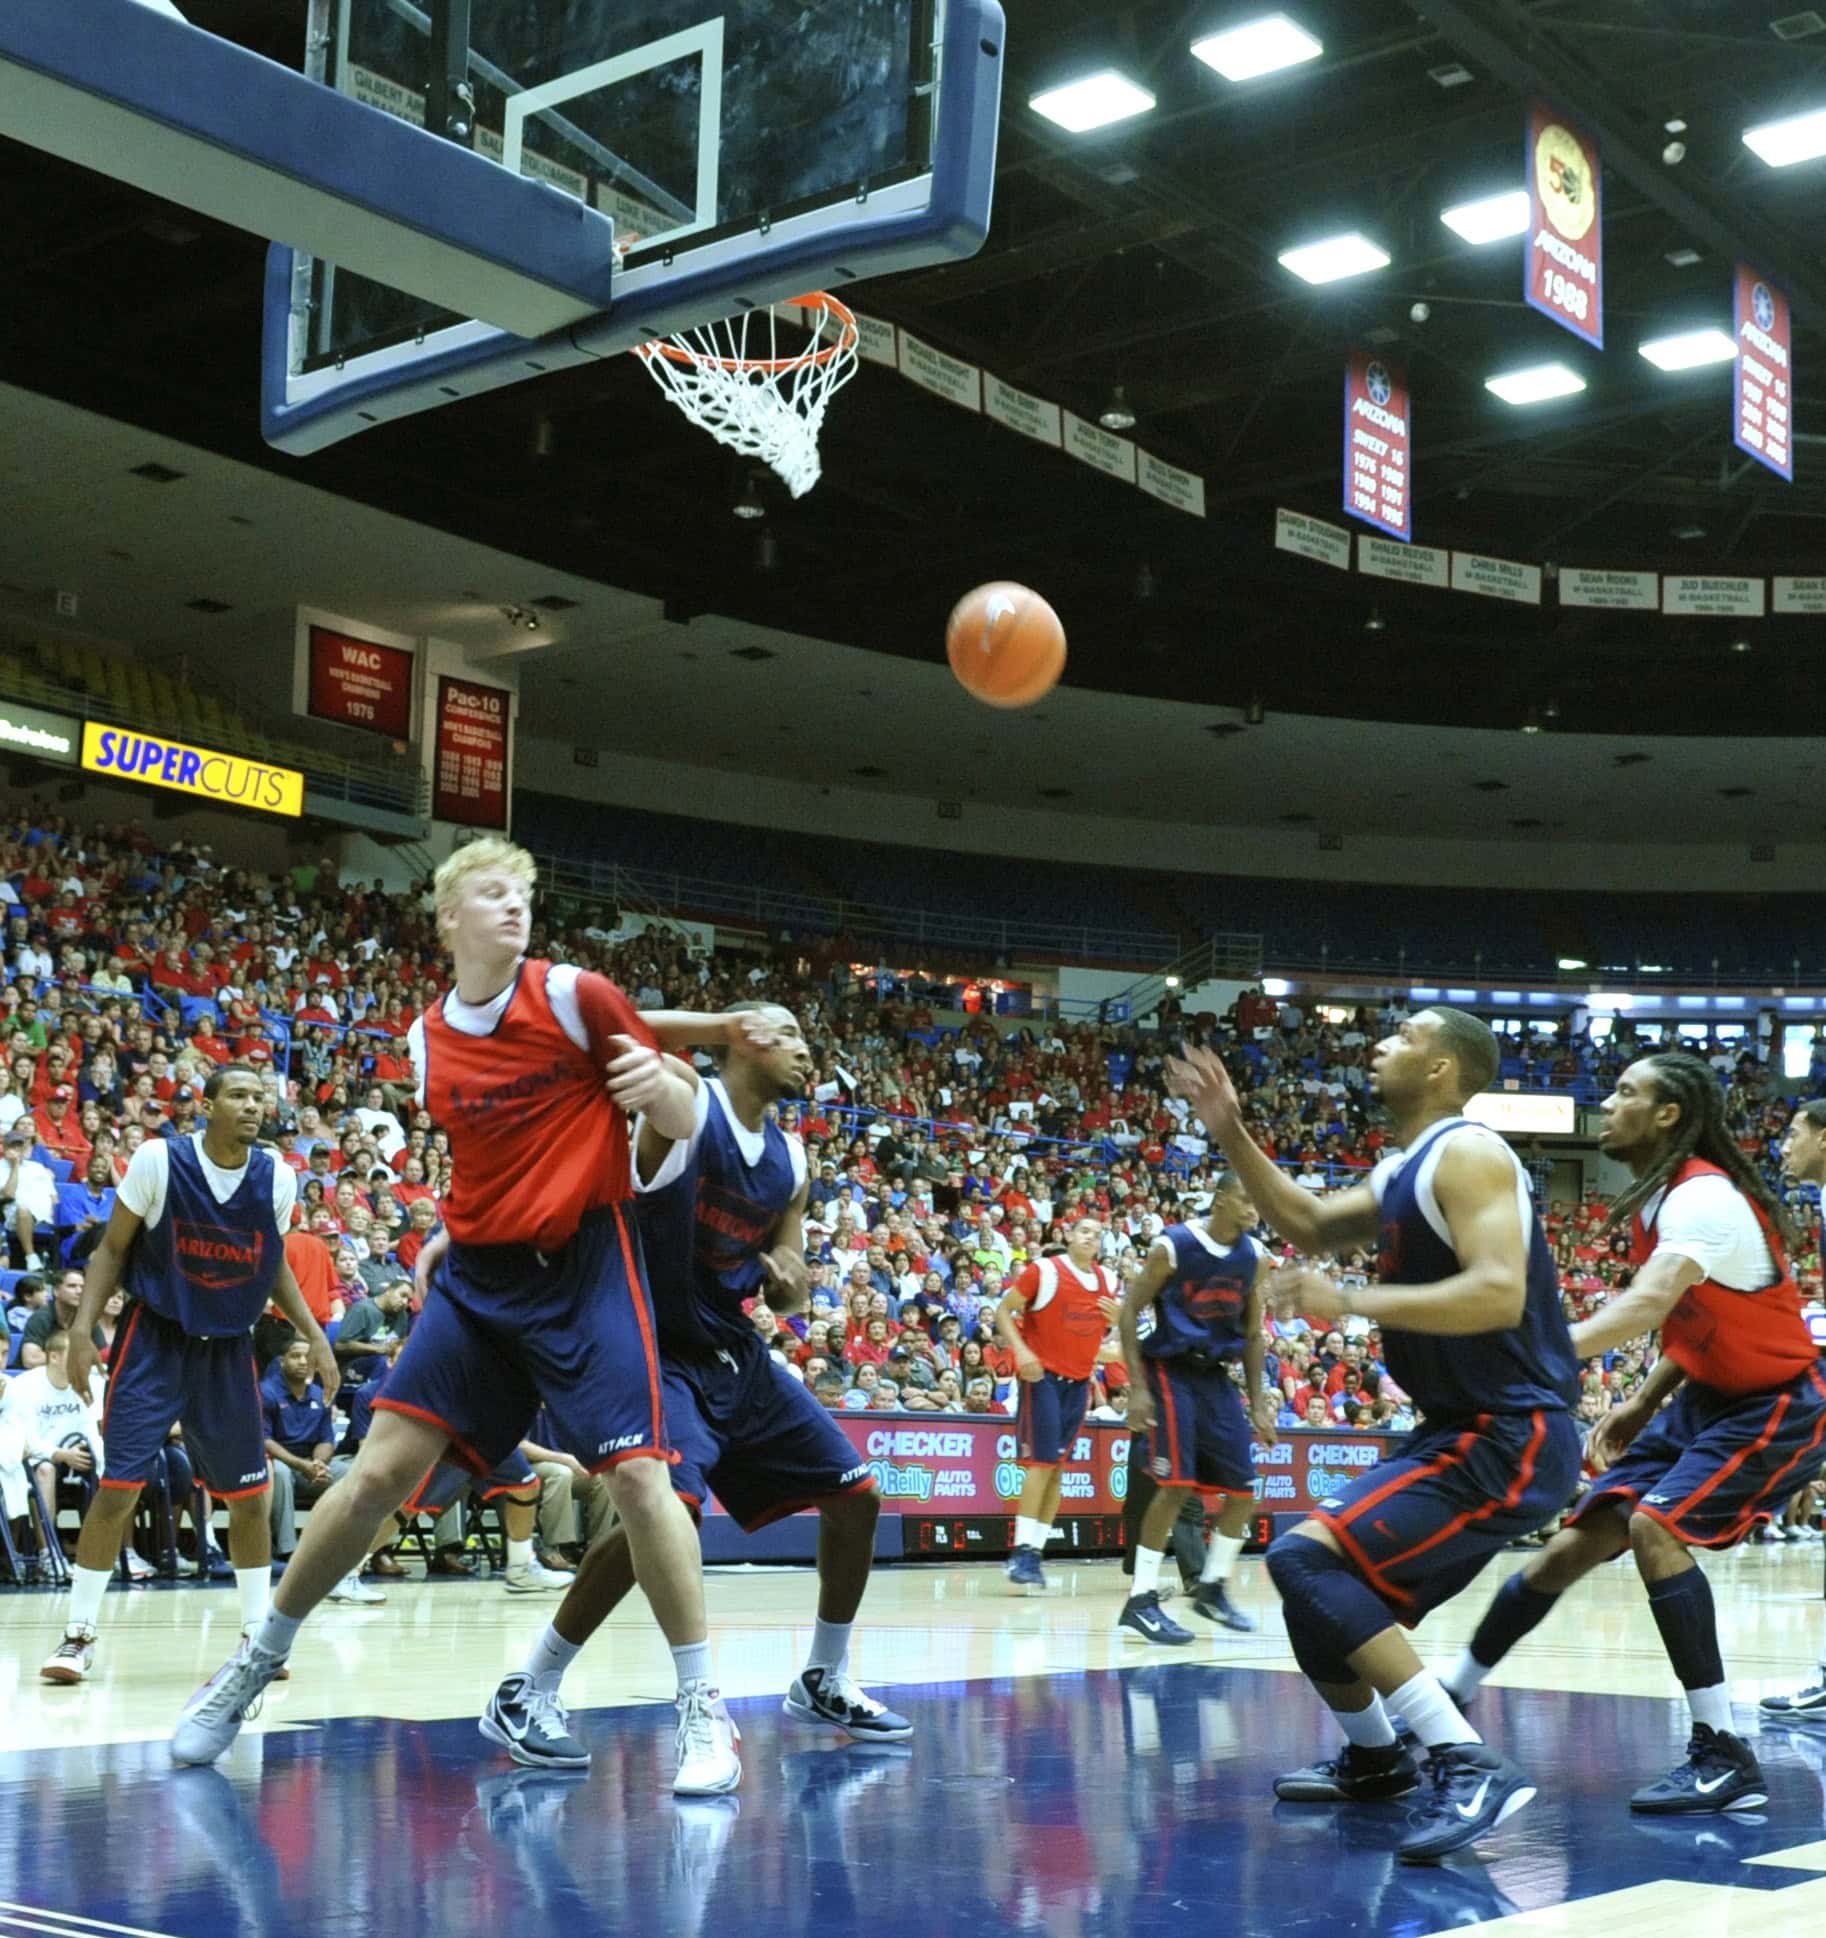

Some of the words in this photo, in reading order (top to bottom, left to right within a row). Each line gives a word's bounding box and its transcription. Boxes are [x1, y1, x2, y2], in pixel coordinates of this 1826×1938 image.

[1534, 229, 1596, 285] ARIZONA
[1544, 268, 1588, 320] 1988
[1353, 397, 1406, 437] ARIZONA
[1402, 546, 1435, 562] REEVES
[1471, 557, 1498, 572] CHRIS
[1498, 563, 1523, 579] MILLS
[1578, 572, 1604, 584] SEAN
[1606, 572, 1638, 586] ROOKS
[1464, 570, 1529, 590] M-BASKETBALL
[1680, 579, 1699, 591] JUD
[1701, 580, 1750, 592] BUECHLER
[1678, 593, 1751, 603] M-BASKETBALL
[341, 644, 382, 671] WAC
[346, 700, 375, 721] 1976
[447, 685, 501, 714] Pac-10
[445, 702, 502, 724] CONFERENCE
[95, 731, 286, 807] SUPERCUTS
[176, 1236, 256, 1264] ARIZONA
[866, 1430, 976, 1457] CHECKER
[1308, 1443, 1380, 1466] CHECKER
[868, 1460, 934, 1501] O'Reilly
[935, 1470, 973, 1484] AUTO
[1265, 1475, 1293, 1487] AUTO
[934, 1483, 977, 1497] PARTS
[1264, 1486, 1297, 1499] PARTS
